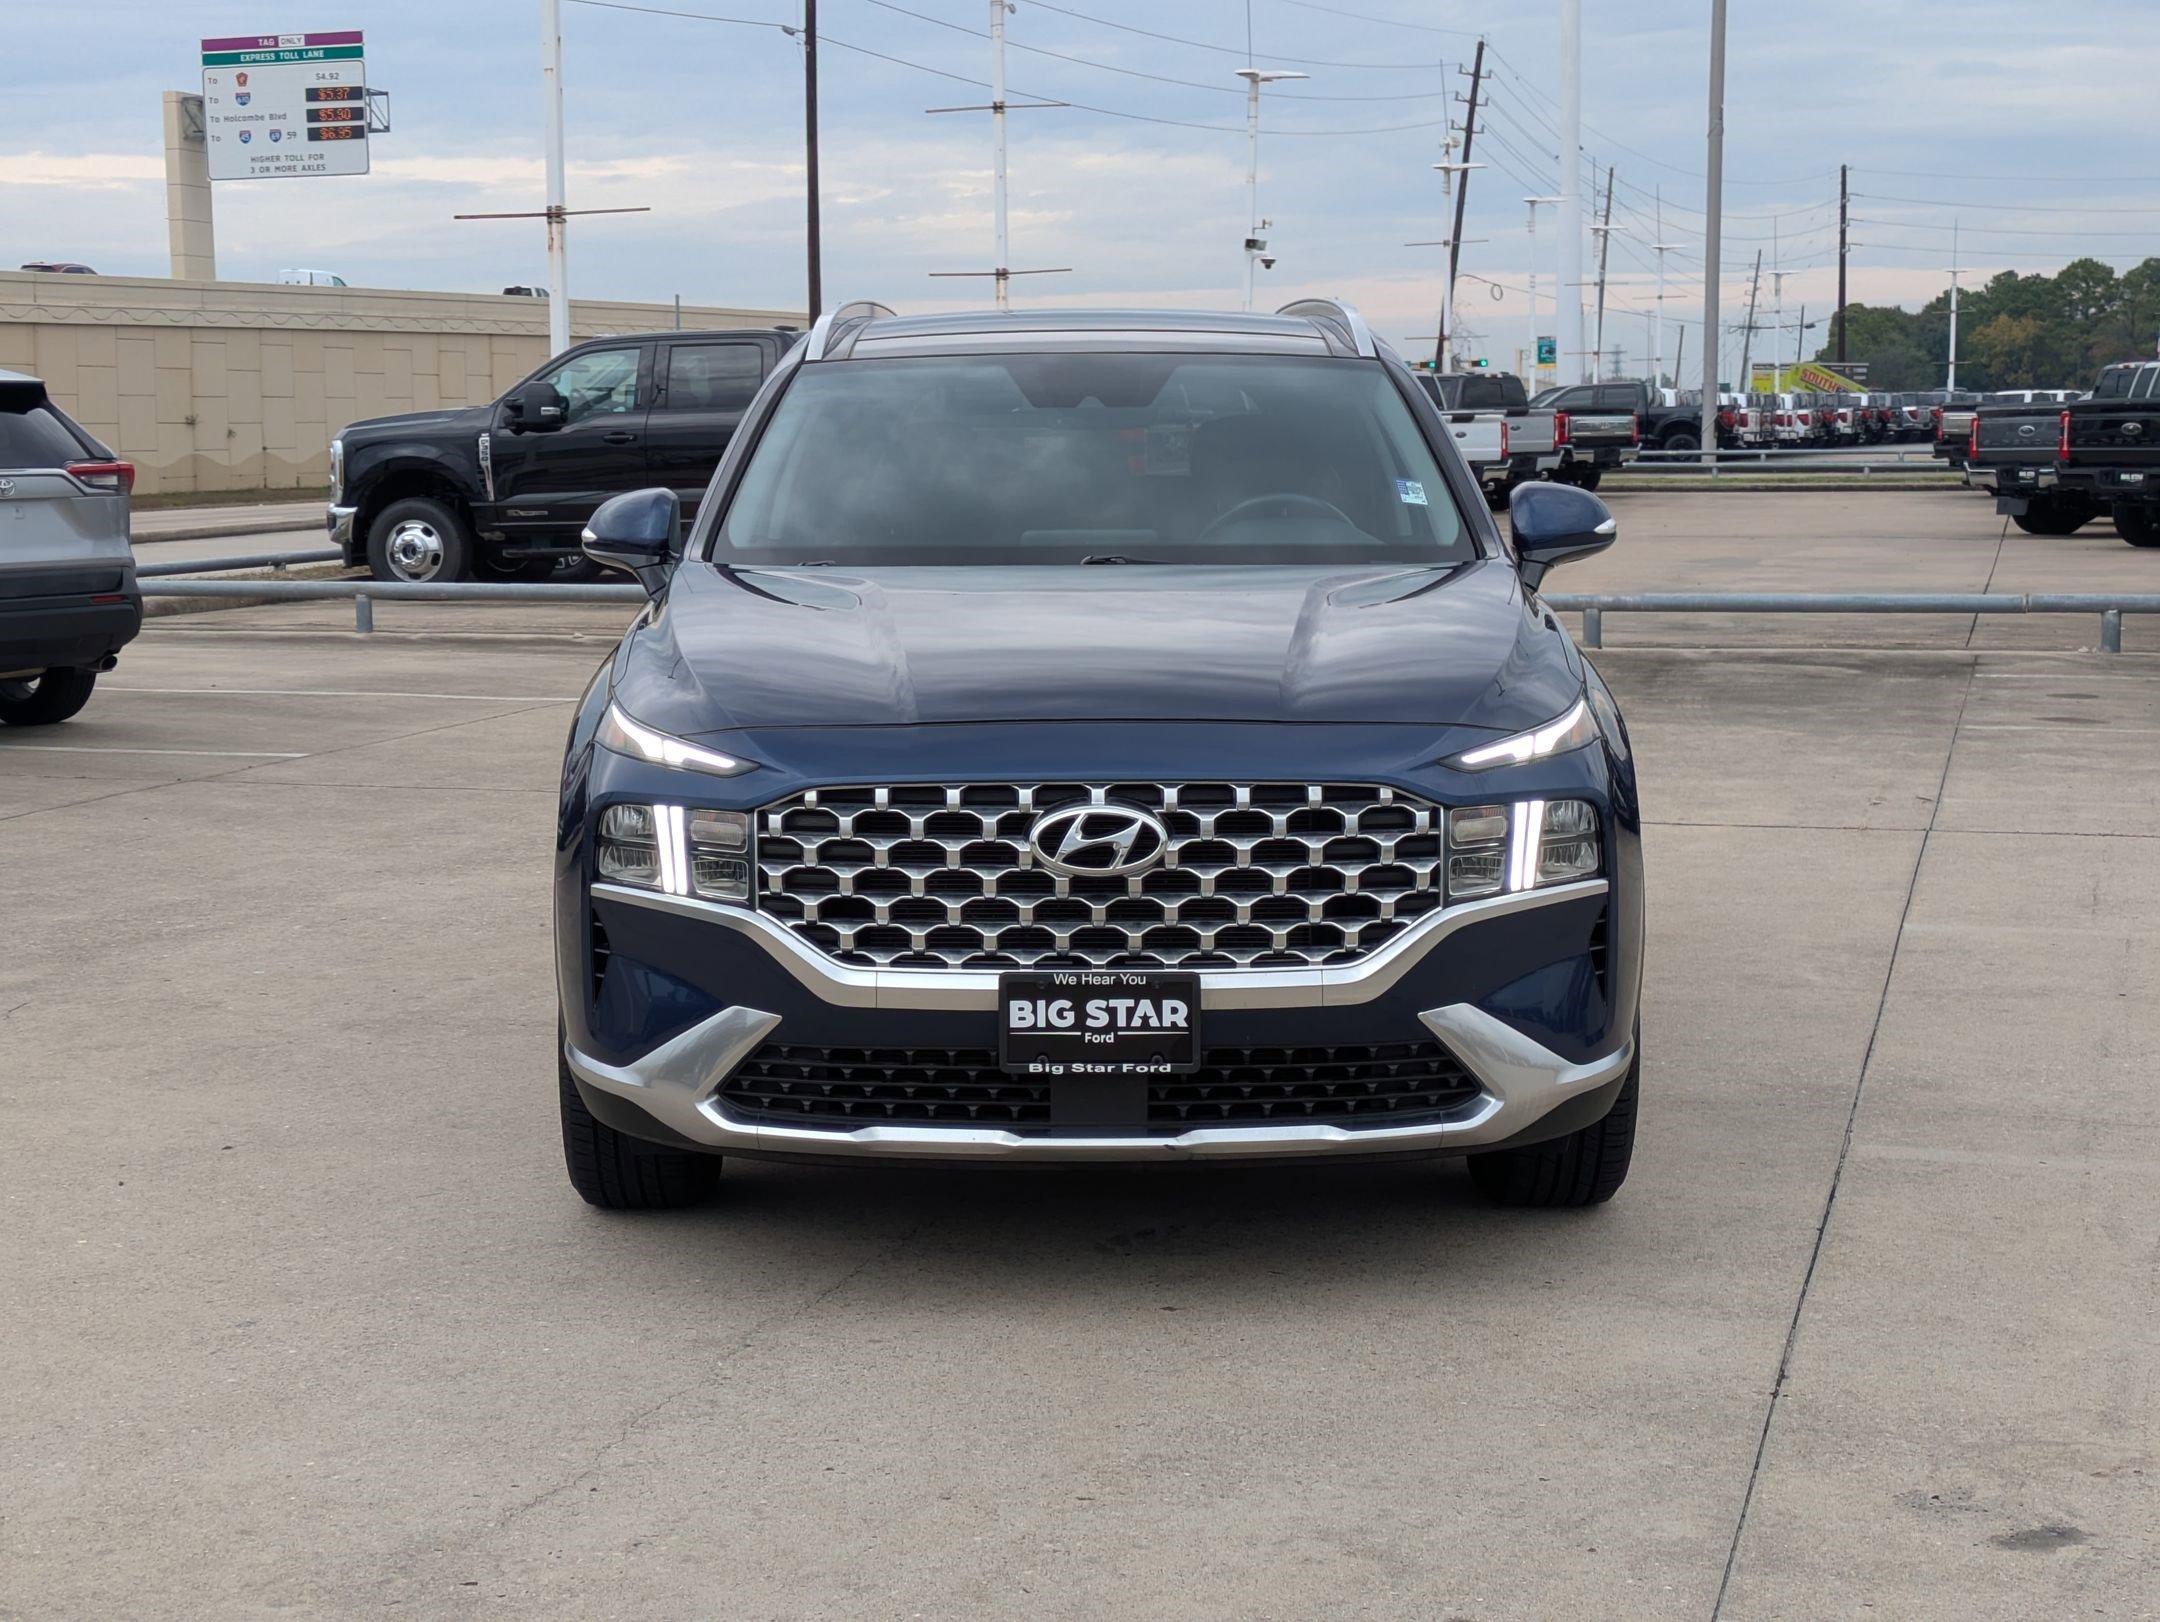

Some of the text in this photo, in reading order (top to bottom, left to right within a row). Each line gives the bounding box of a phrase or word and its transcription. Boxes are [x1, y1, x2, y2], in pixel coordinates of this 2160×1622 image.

[258, 37, 303, 46] TAG ONLY
[240, 50, 325, 62] EXPRESS TOLL LANE
[207, 77, 218, 85] To
[319, 88, 350, 100] $5.37
[223, 113, 265, 122] Holcombe
[269, 112, 287, 121] Blvd
[251, 153, 325, 163] HIGHER TOLL FOR
[251, 164, 326, 174] 3 OR MORE AXLES
[1053, 974, 1146, 985] We Hear You
[1009, 999, 1189, 1028] BIG STAR
[1084, 1032, 1114, 1043] Ford
[1029, 1063, 1171, 1075] Big Star Ford
